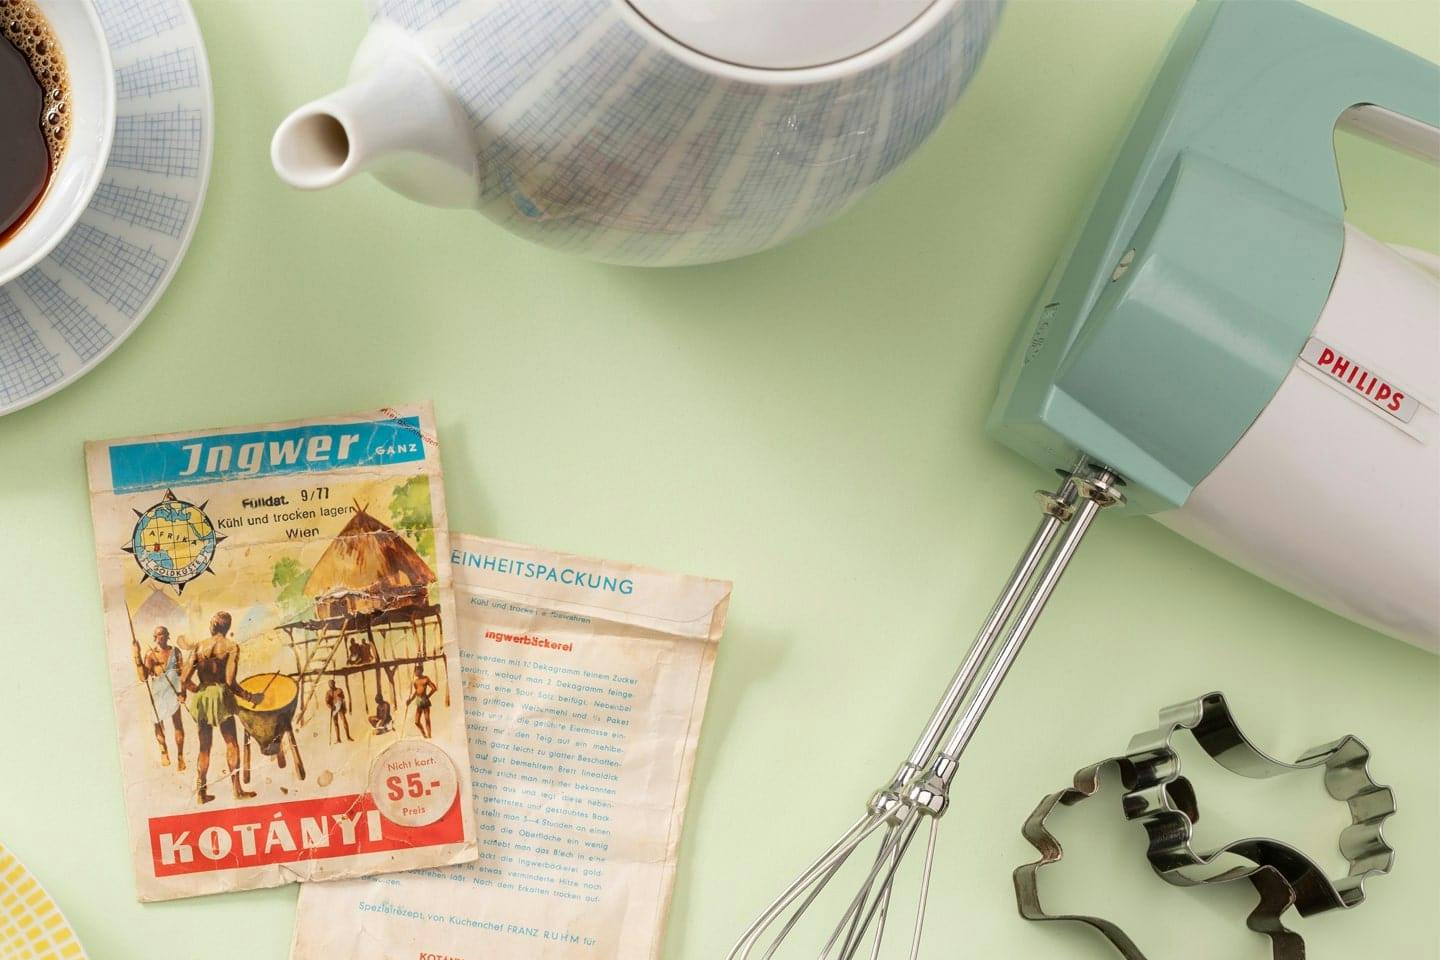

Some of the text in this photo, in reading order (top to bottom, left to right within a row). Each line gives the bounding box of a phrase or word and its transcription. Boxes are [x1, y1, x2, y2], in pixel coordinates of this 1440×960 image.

[1318, 348, 1404, 411] PHILIPS
[375, 444, 418, 455] GANZ
[218, 505, 355, 530] Kühl und trocken lagern
[149, 530, 197, 546] AFRIKA
[285, 526, 320, 539] Wien
[450, 549, 634, 596] EINHEITSPACKUNG
[492, 601, 506, 610] und
[477, 656, 506, 664] werden
[508, 658, 520, 666] mit
[533, 662, 580, 676] Dekagramm
[612, 674, 638, 686] Zucker
[556, 680, 604, 694] Dekagramm
[606, 716, 630, 726] Paket
[388, 757, 437, 772] Nicht kart.
[575, 782, 616, 795] bekannten
[402, 806, 426, 816] Preis
[542, 818, 574, 829] Stunden
[159, 811, 383, 866] KOTÁNYI
[584, 840, 609, 852] wenig
[479, 865, 502, 876] etwas
[473, 877, 494, 888] Nach
[497, 880, 514, 890] dem
[518, 884, 550, 895] Erkalten
[554, 890, 582, 900] trocken
[428, 914, 444, 922] von
[507, 924, 540, 937] FRANZ
[544, 931, 580, 944] RUHM
